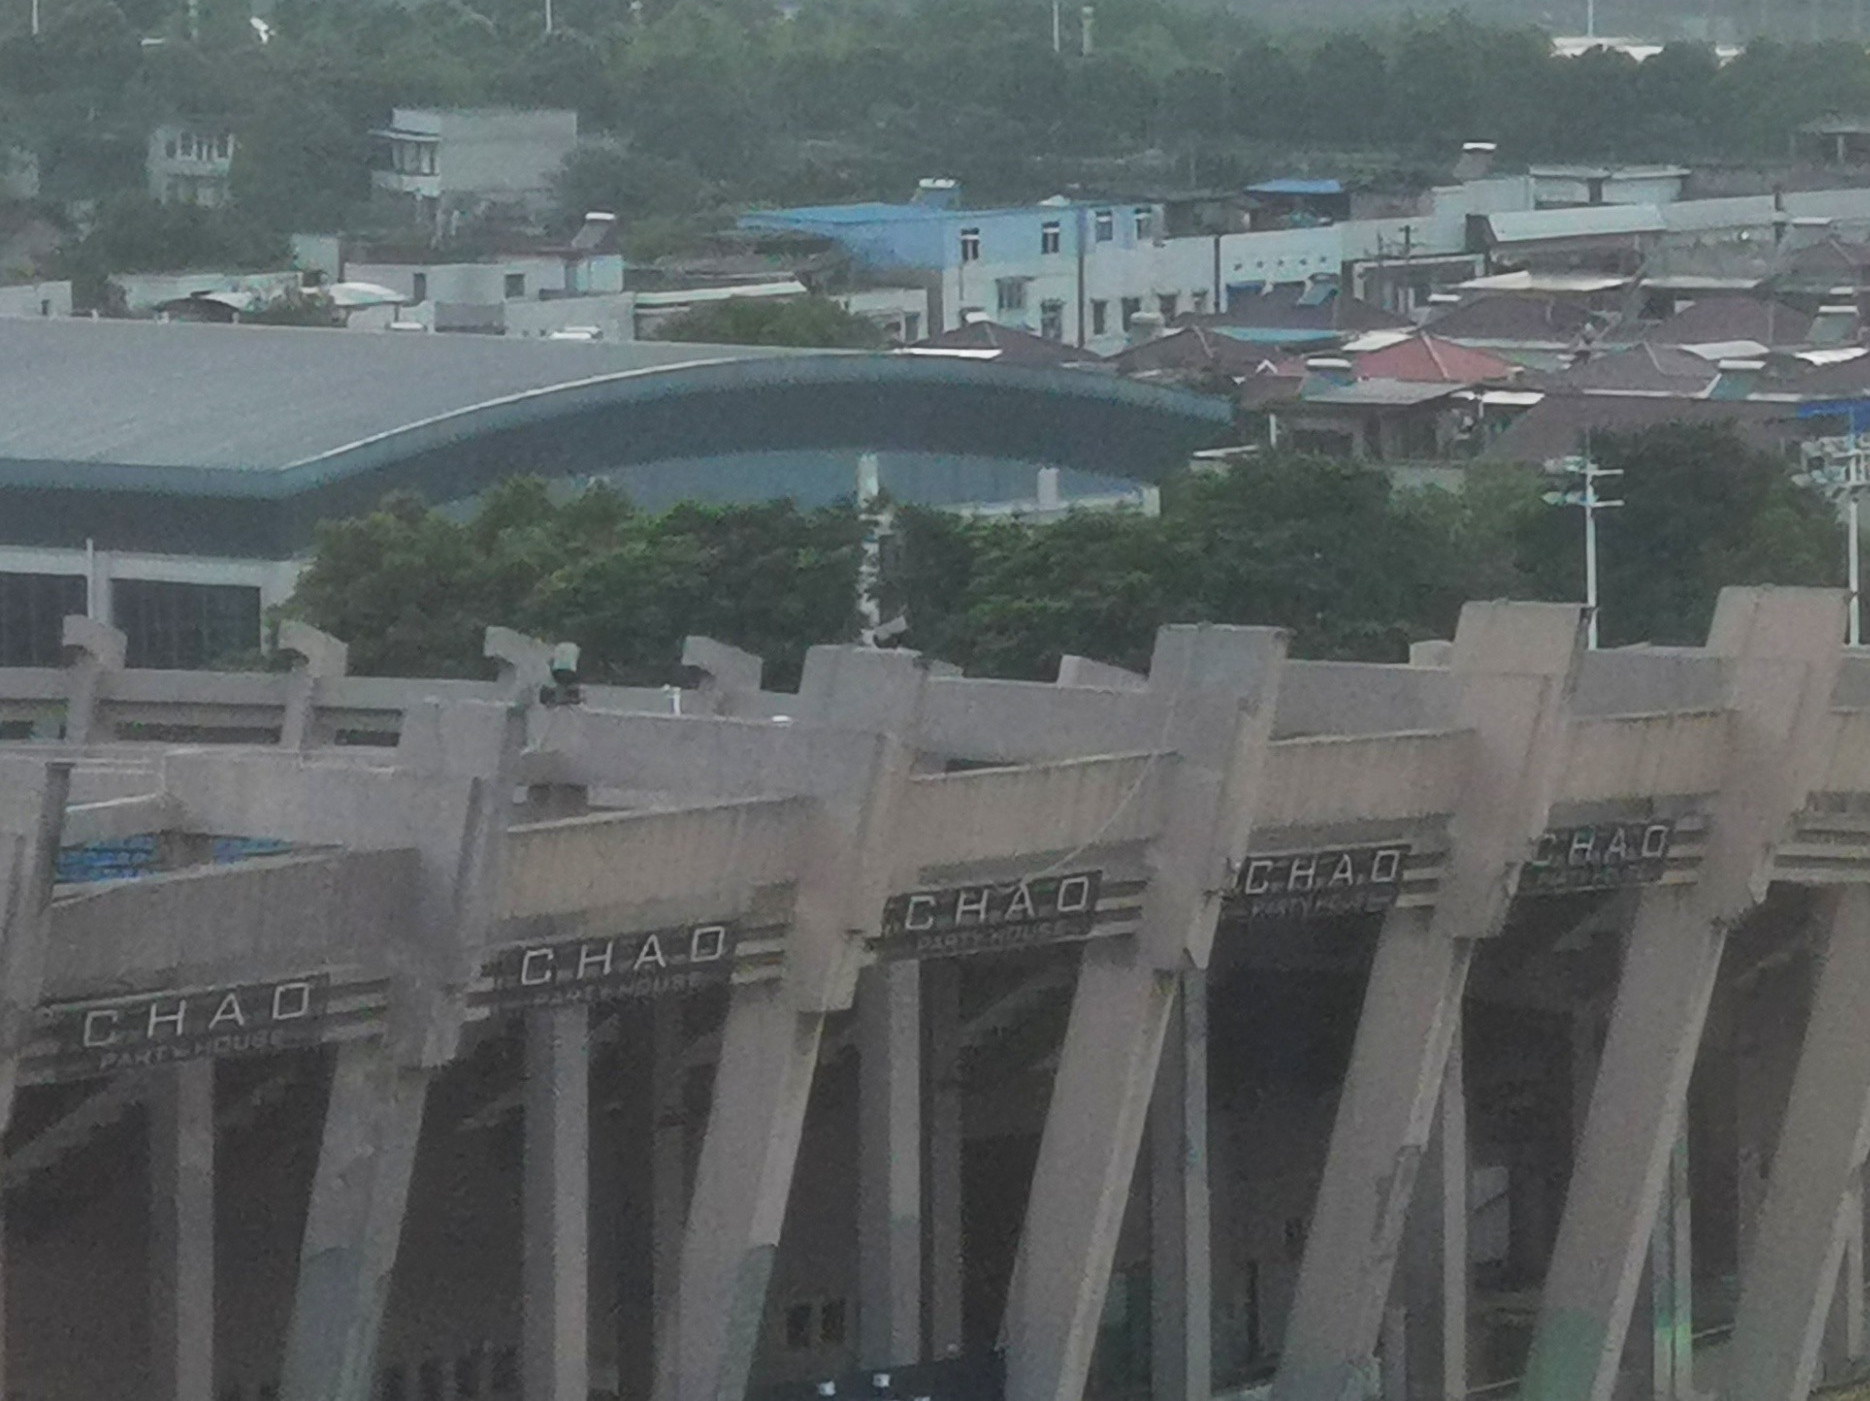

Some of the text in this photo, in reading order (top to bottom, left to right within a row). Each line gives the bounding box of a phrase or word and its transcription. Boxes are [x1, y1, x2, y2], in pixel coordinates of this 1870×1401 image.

[1245, 849, 1400, 895] CHAO
[1530, 824, 1669, 867] CHAO
[904, 876, 1089, 930] CHAO
[521, 926, 725, 985] CHAO
[84, 982, 309, 1047] CHAO
